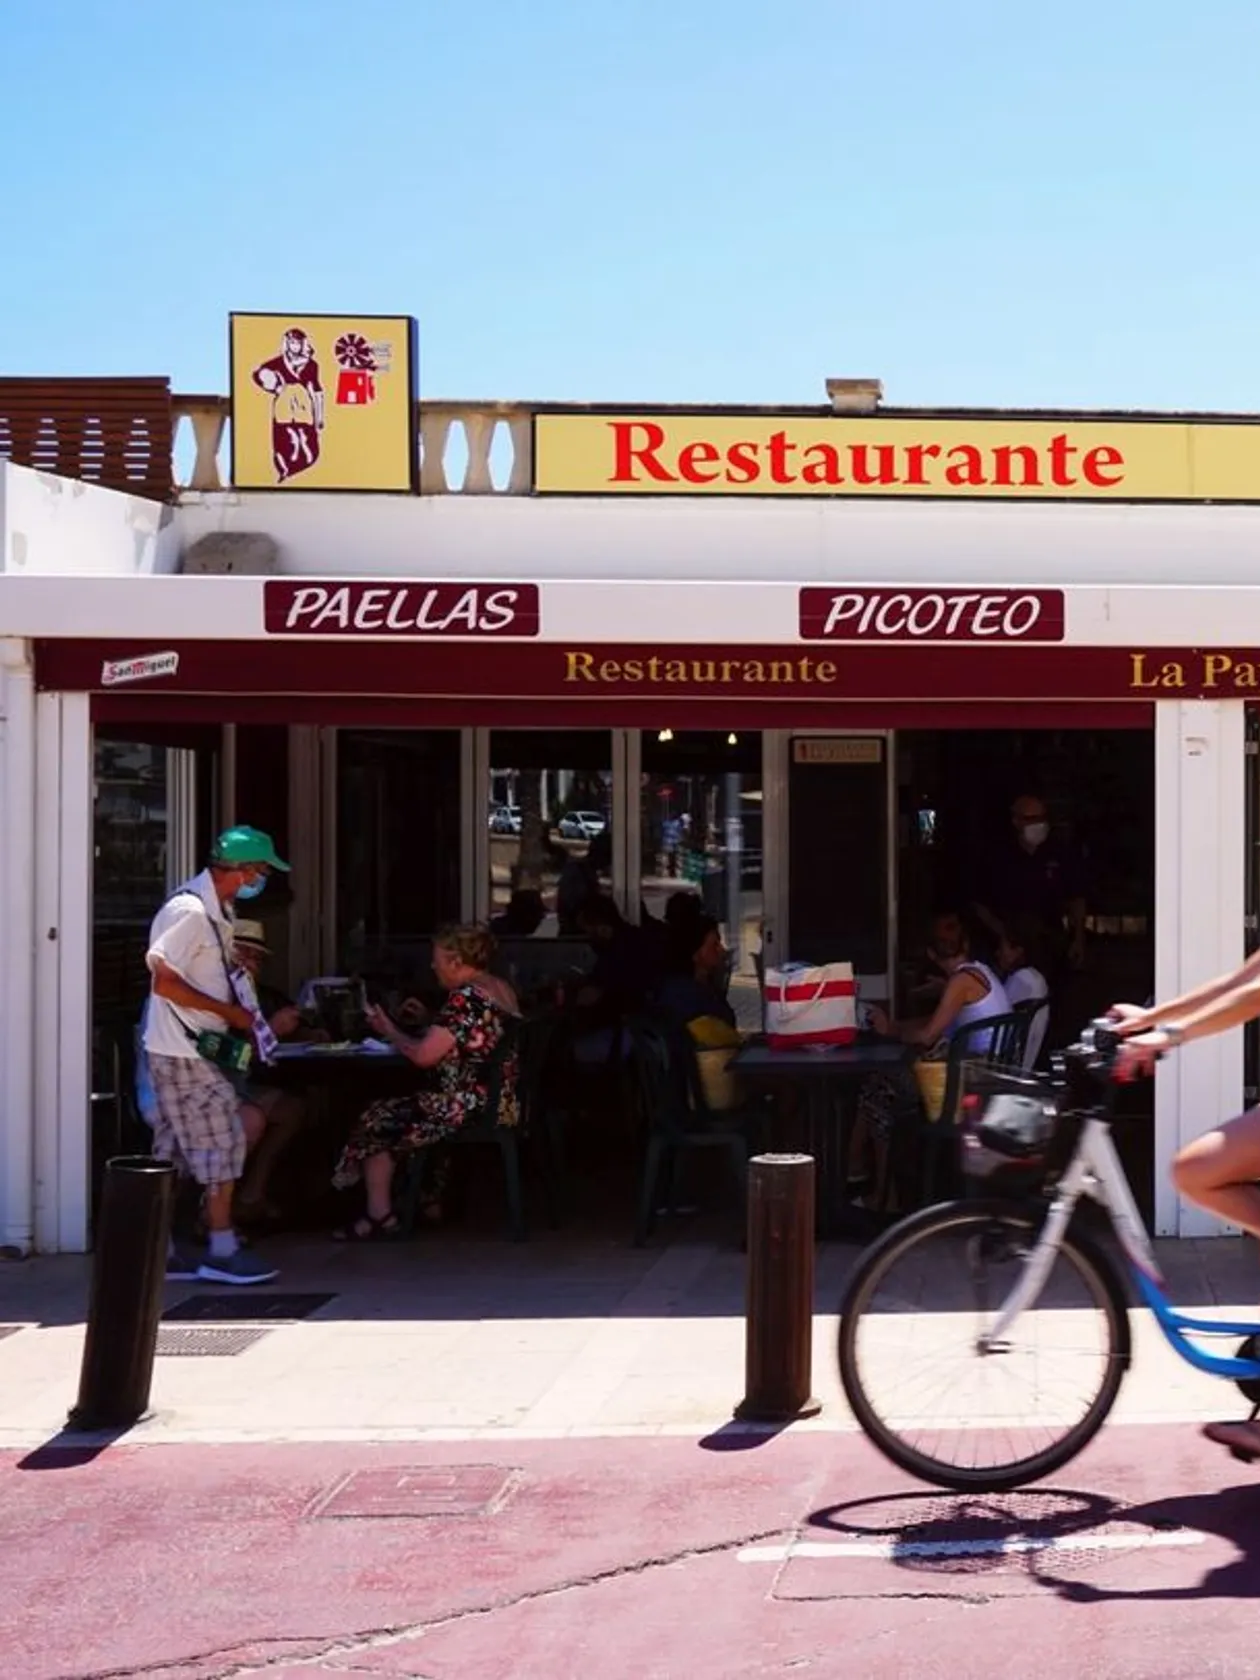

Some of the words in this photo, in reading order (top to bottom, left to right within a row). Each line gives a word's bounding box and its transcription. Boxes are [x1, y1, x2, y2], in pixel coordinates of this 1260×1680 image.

[608, 420, 1125, 487] Restaurante
[285, 587, 517, 630] PAELLAS
[823, 594, 1040, 637] PICOTEO
[565, 651, 838, 682] Restaurante
[1130, 653, 1184, 686] La
